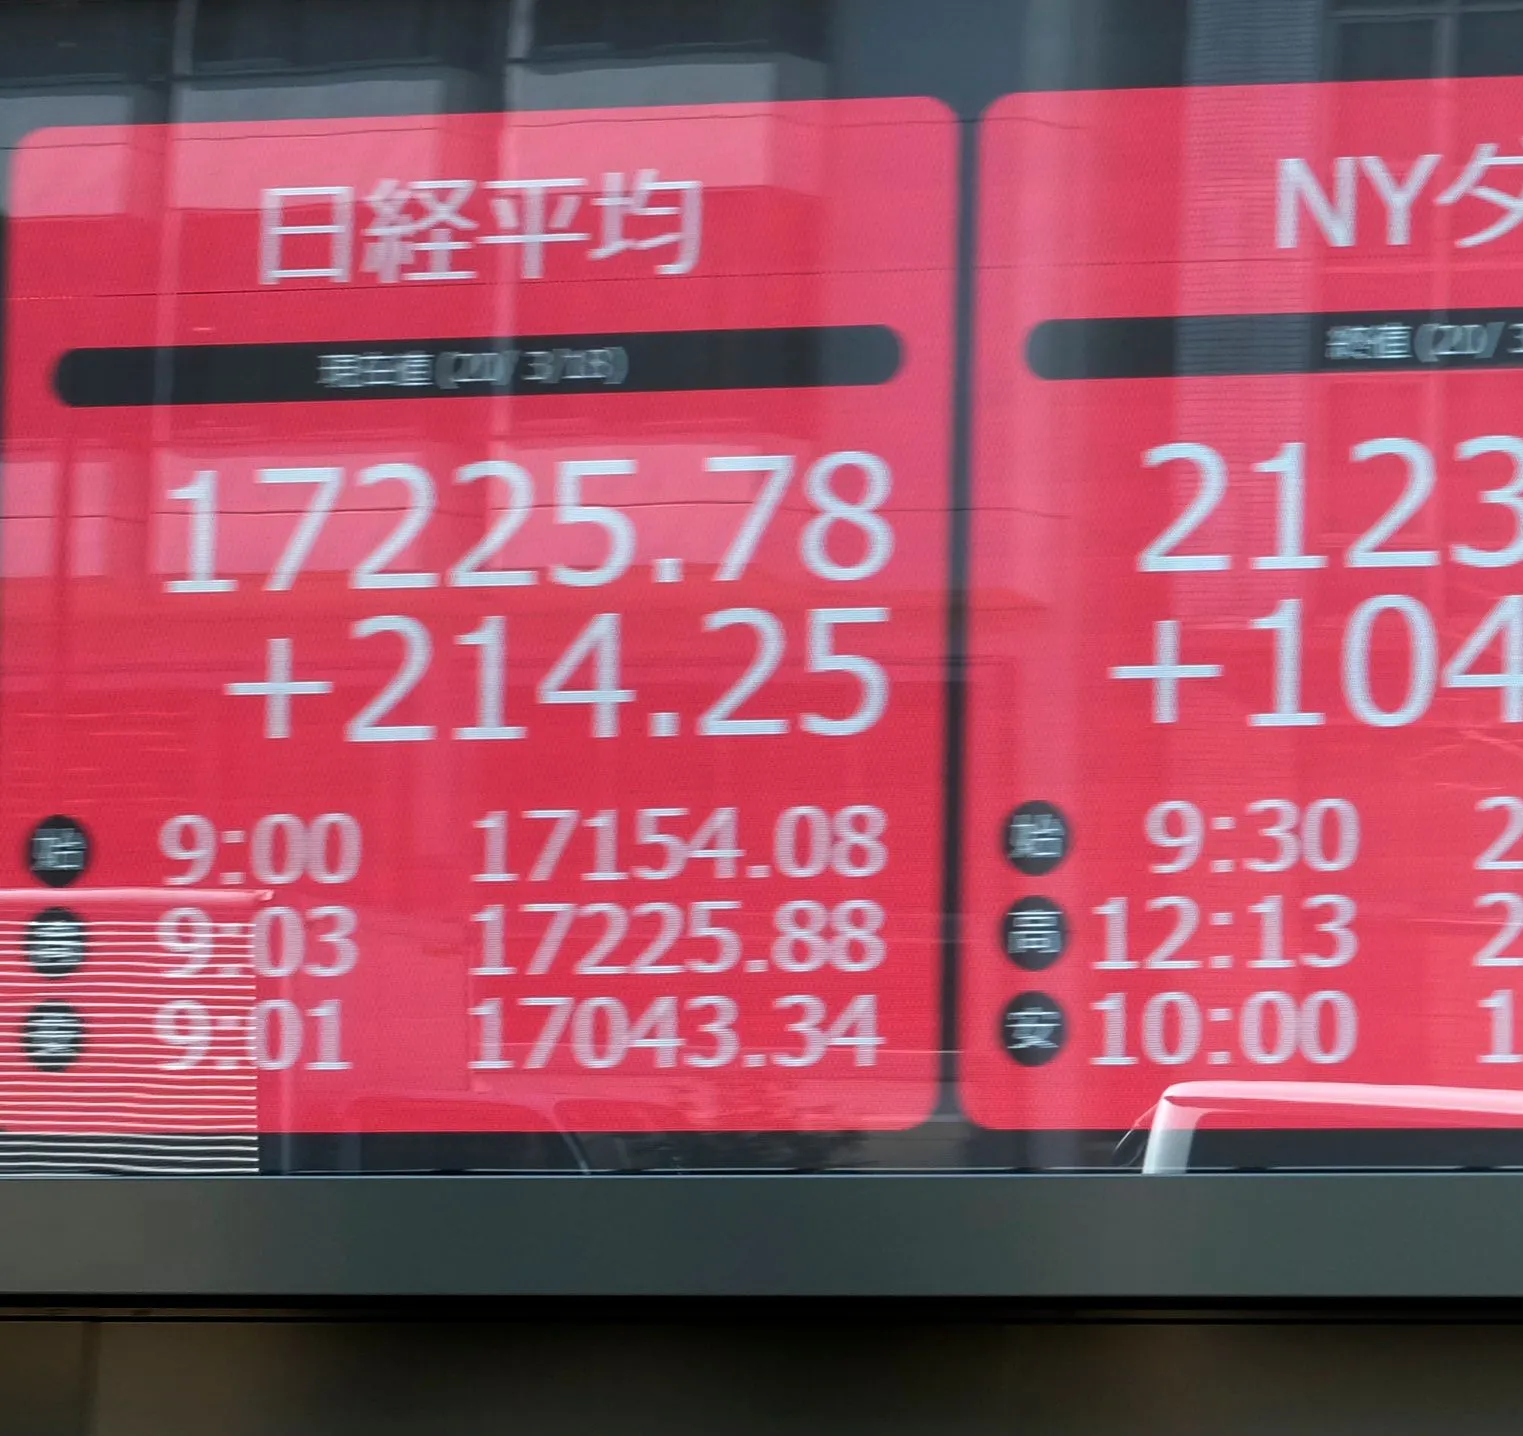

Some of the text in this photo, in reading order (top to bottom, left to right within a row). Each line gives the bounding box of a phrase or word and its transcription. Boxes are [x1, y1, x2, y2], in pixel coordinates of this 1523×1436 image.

[258, 168, 704, 286] 日経平均
[163, 450, 895, 595] 17225.78
[225, 606, 891, 743] +214.25
[157, 812, 363, 887] 9:00
[473, 804, 889, 884] 17154.08
[1143, 797, 1361, 875] 9:30
[154, 904, 360, 980] 9:03
[472, 899, 889, 978] 17225.88
[1006, 908, 1063, 954] 高
[1091, 893, 1360, 971] 12:13
[152, 997, 354, 1074] 9:01
[468, 993, 885, 1073] 17043.34
[1005, 1006, 1062, 1050] 安
[1089, 989, 1359, 1068] 10:00
